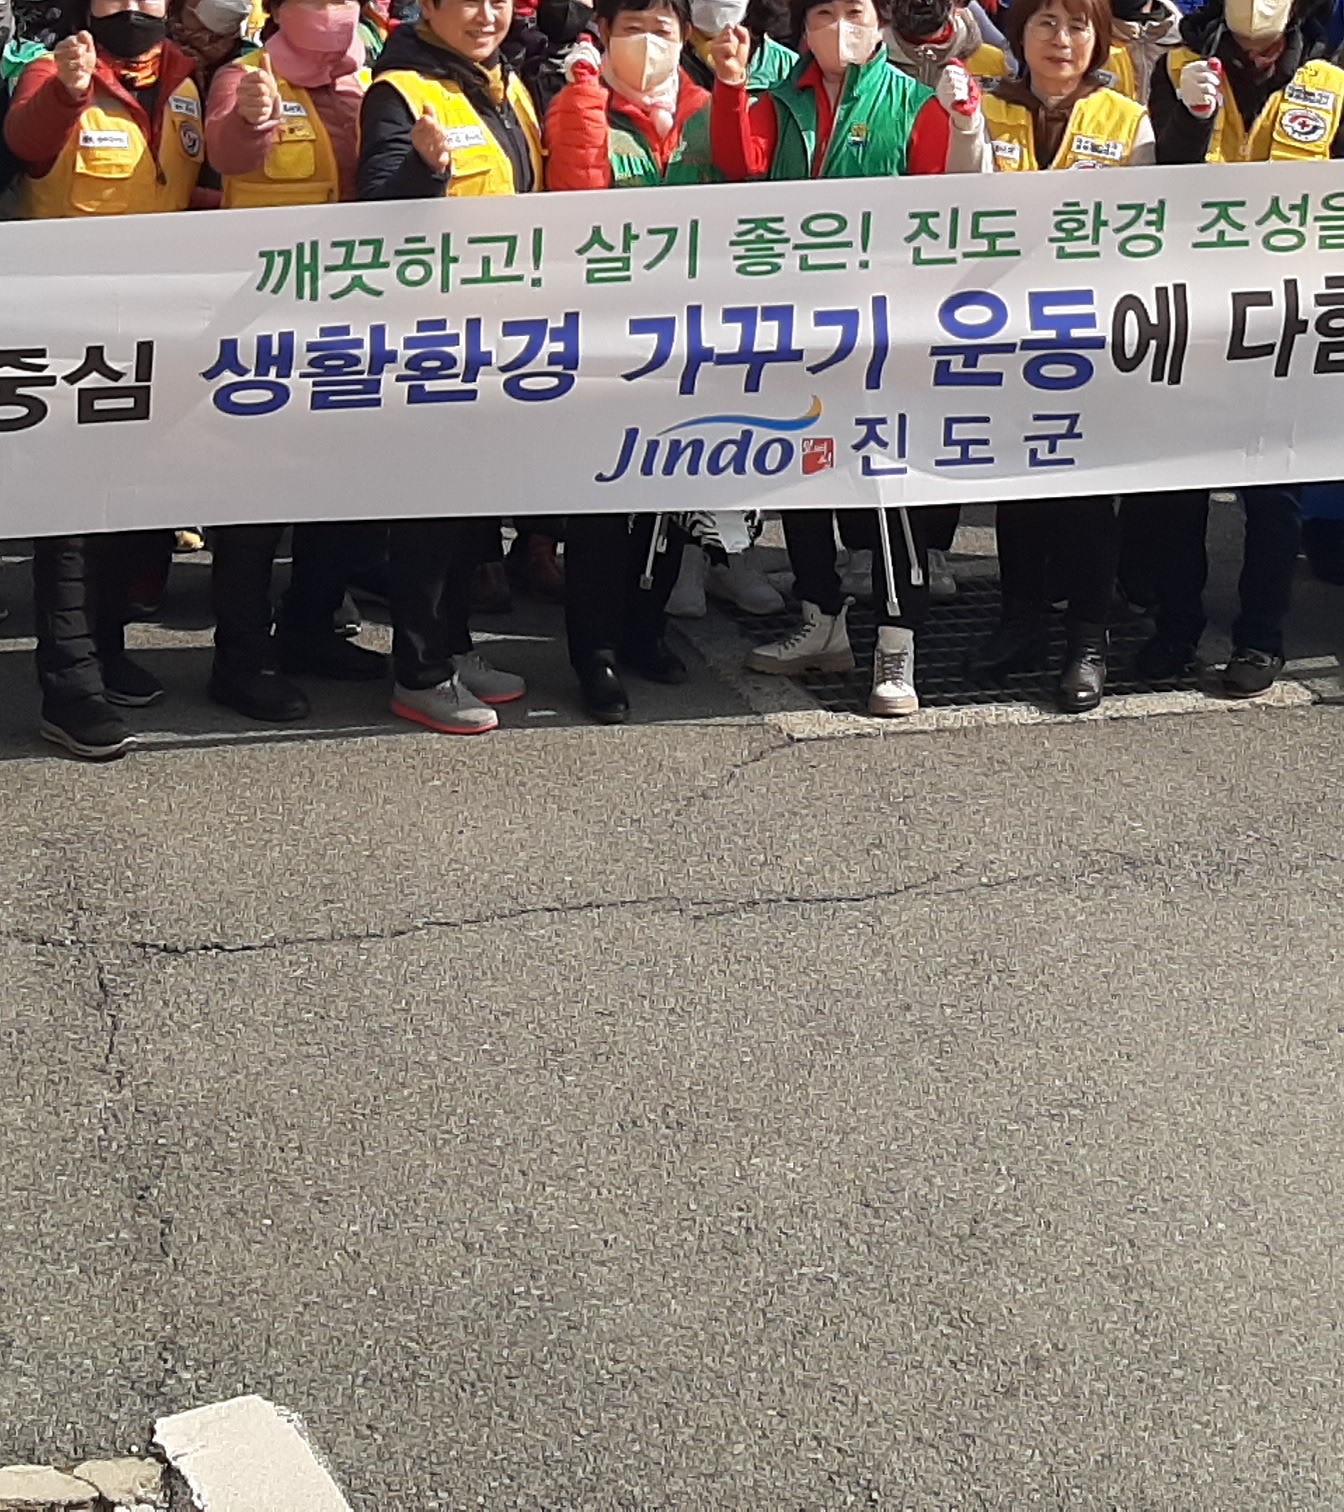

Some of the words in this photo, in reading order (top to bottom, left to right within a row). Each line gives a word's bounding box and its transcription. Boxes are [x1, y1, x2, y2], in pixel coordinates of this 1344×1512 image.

[258, 228, 544, 301] 깨끗하고!
[576, 220, 700, 284] 살기
[729, 212, 872, 277] 좋은!
[902, 207, 1022, 266] 진도
[1049, 199, 1167, 260] 환경
[199, 311, 581, 417] 생활환경
[620, 295, 890, 396] 가꾸기
[929, 283, 1189, 391] 운동에
[594, 426, 794, 484] Jindo
